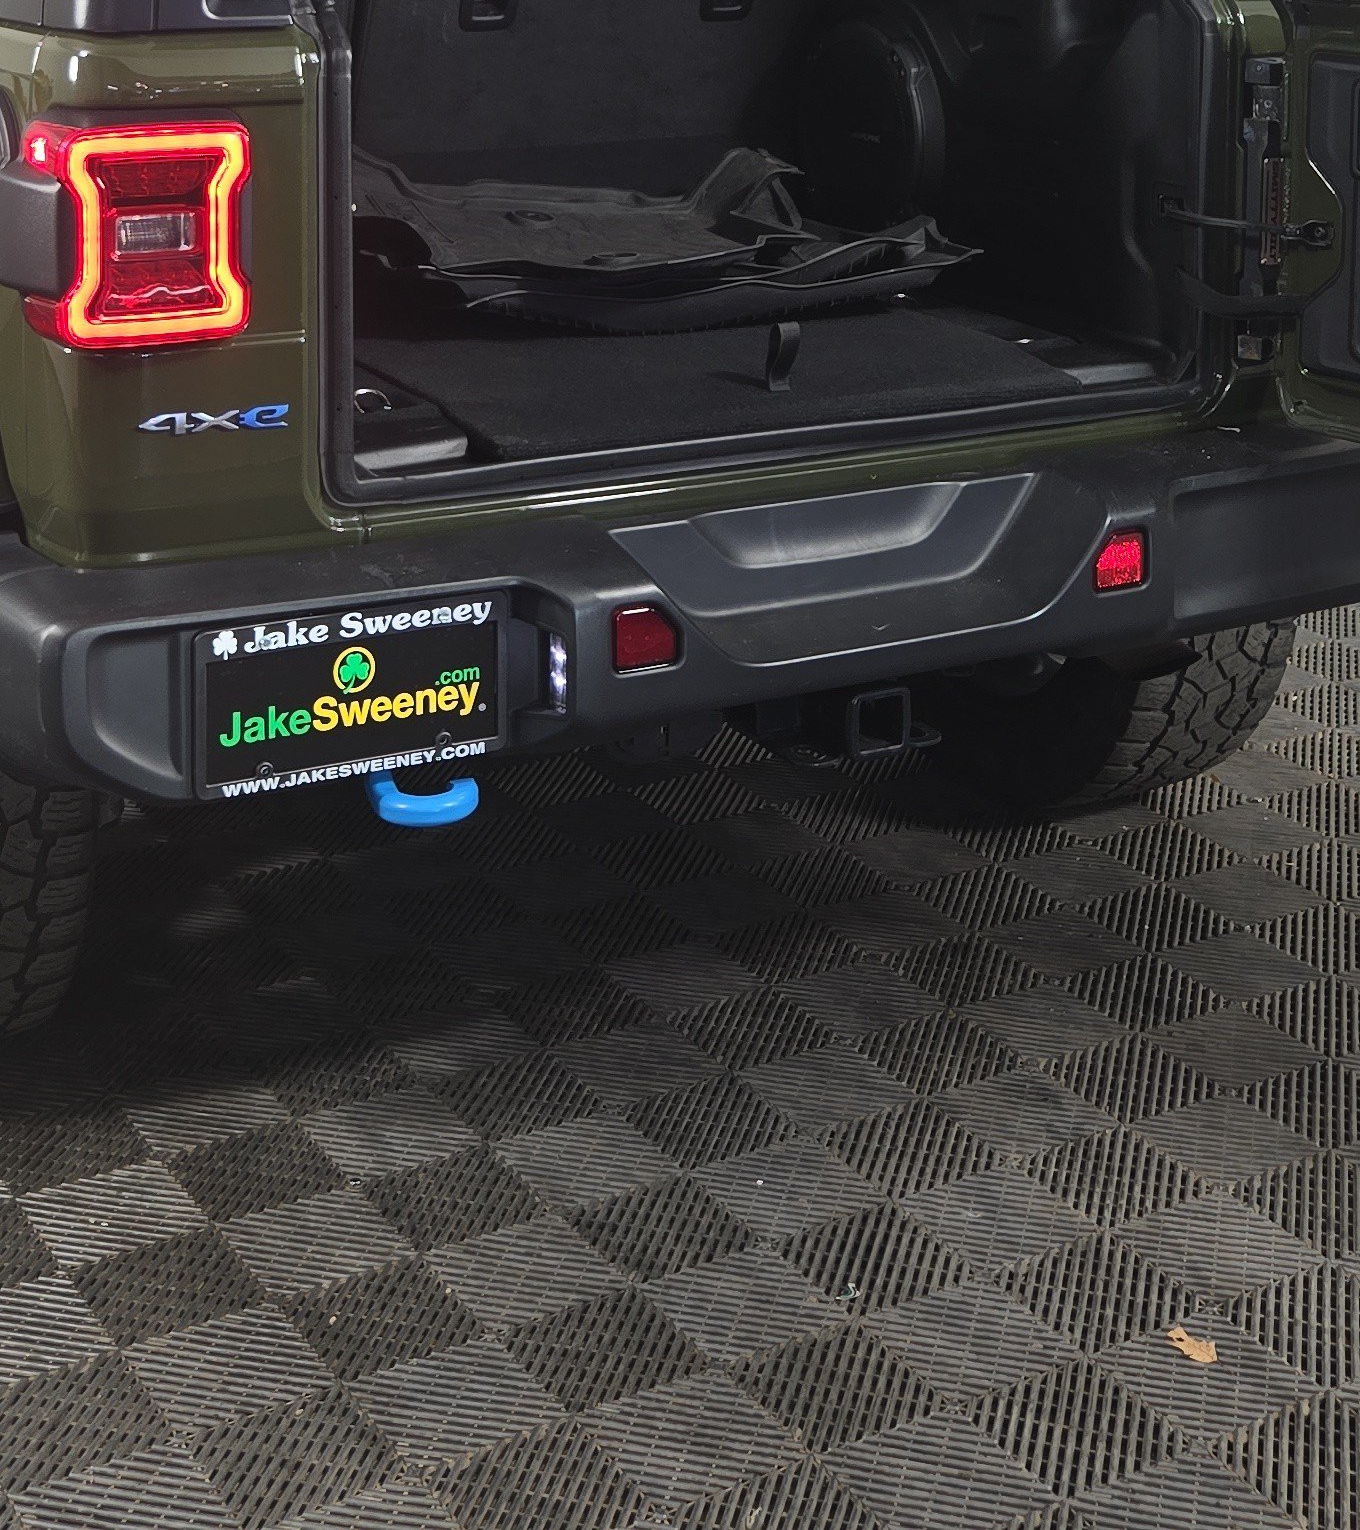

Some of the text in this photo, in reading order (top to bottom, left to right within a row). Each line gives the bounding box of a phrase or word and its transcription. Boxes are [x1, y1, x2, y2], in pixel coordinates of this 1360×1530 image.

[243, 600, 493, 655] Jake Sweeney
[434, 664, 481, 687] .com
[219, 680, 480, 749] JakeSweeney
[220, 741, 487, 799] WWW.JAKESWEENEY.COM
